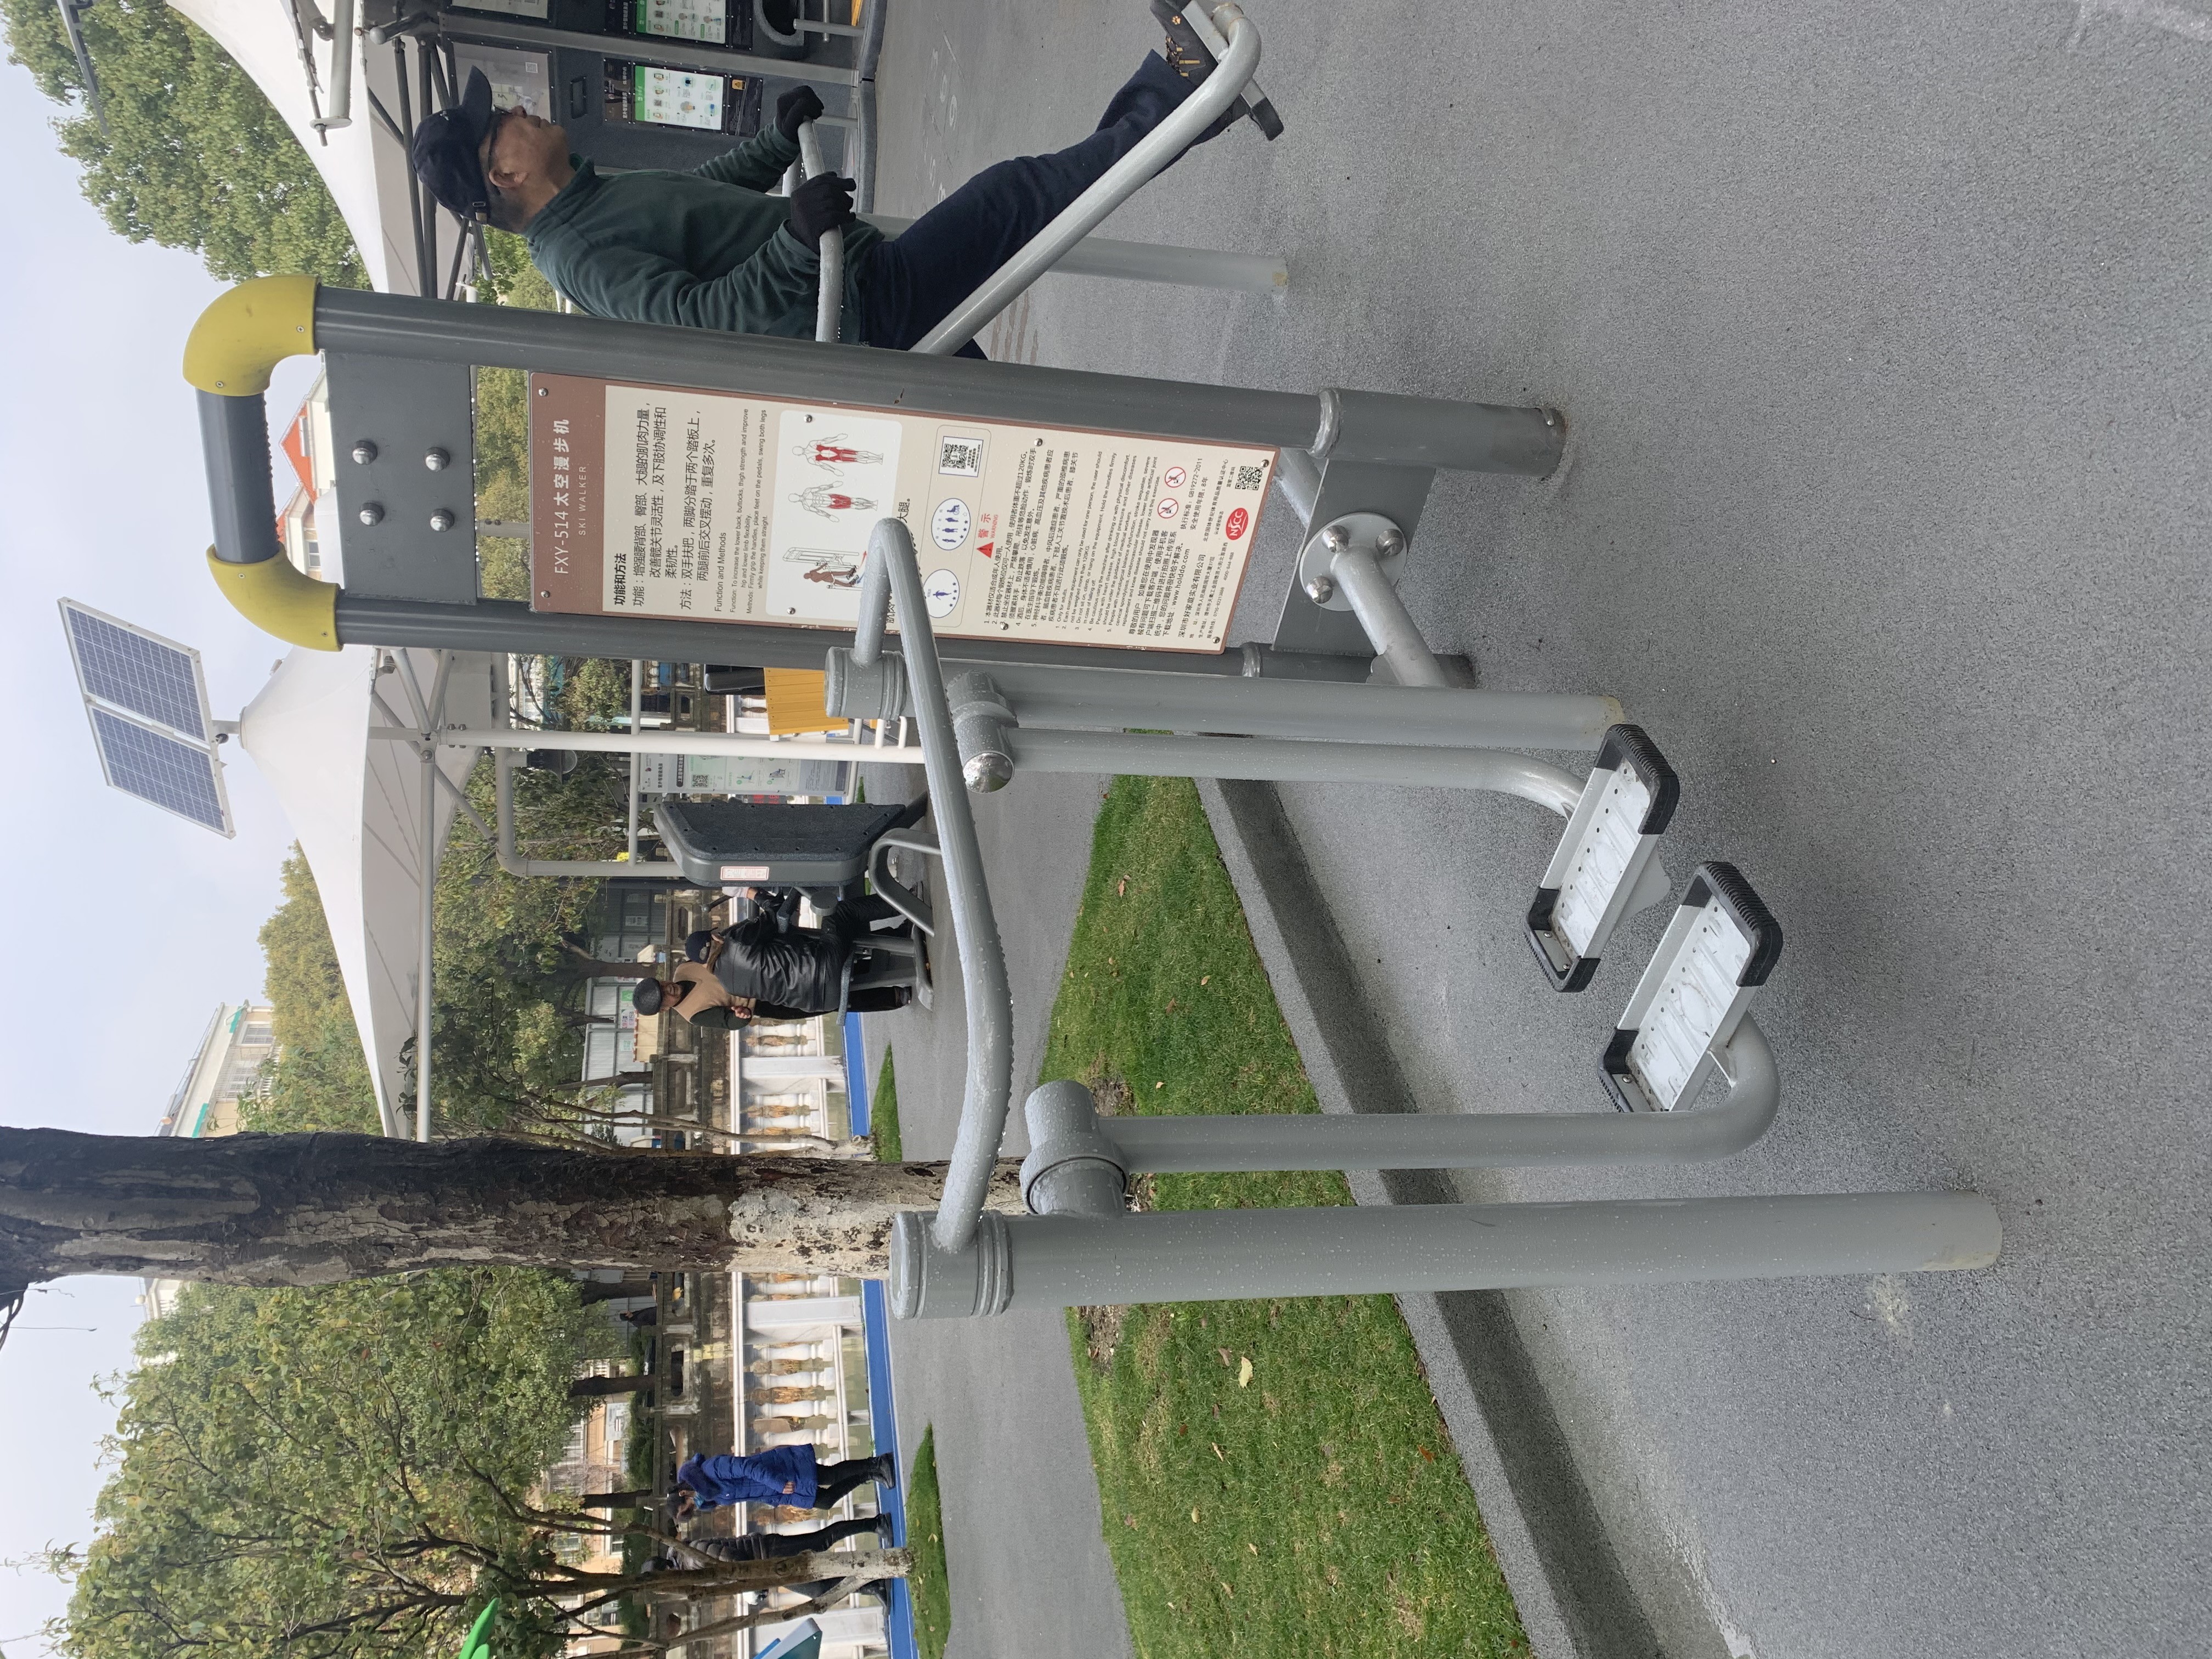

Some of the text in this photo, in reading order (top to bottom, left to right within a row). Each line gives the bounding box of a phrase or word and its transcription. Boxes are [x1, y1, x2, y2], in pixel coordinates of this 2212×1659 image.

[741, 409, 749, 433] improve
[759, 409, 768, 422] legs
[739, 447, 747, 471] strength
[755, 457, 764, 478] pedals,
[737, 472, 746, 486] thigh
[553, 417, 569, 574] FXY-514 太空漫步机
[743, 514, 752, 538] flexibility.
[760, 515, 769, 537] straight.
[990, 514, 998, 539] WARNING
[664, 544, 678, 579] 柔韧性。
[714, 532, 726, 611] Function and Methods
[758, 553, 766, 574] keeping
[613, 552, 627, 606] 功能和方法
[747, 572, 755, 589] Firmly
[1177, 554, 1206, 637] 深圳市好家庭实业有限公司
